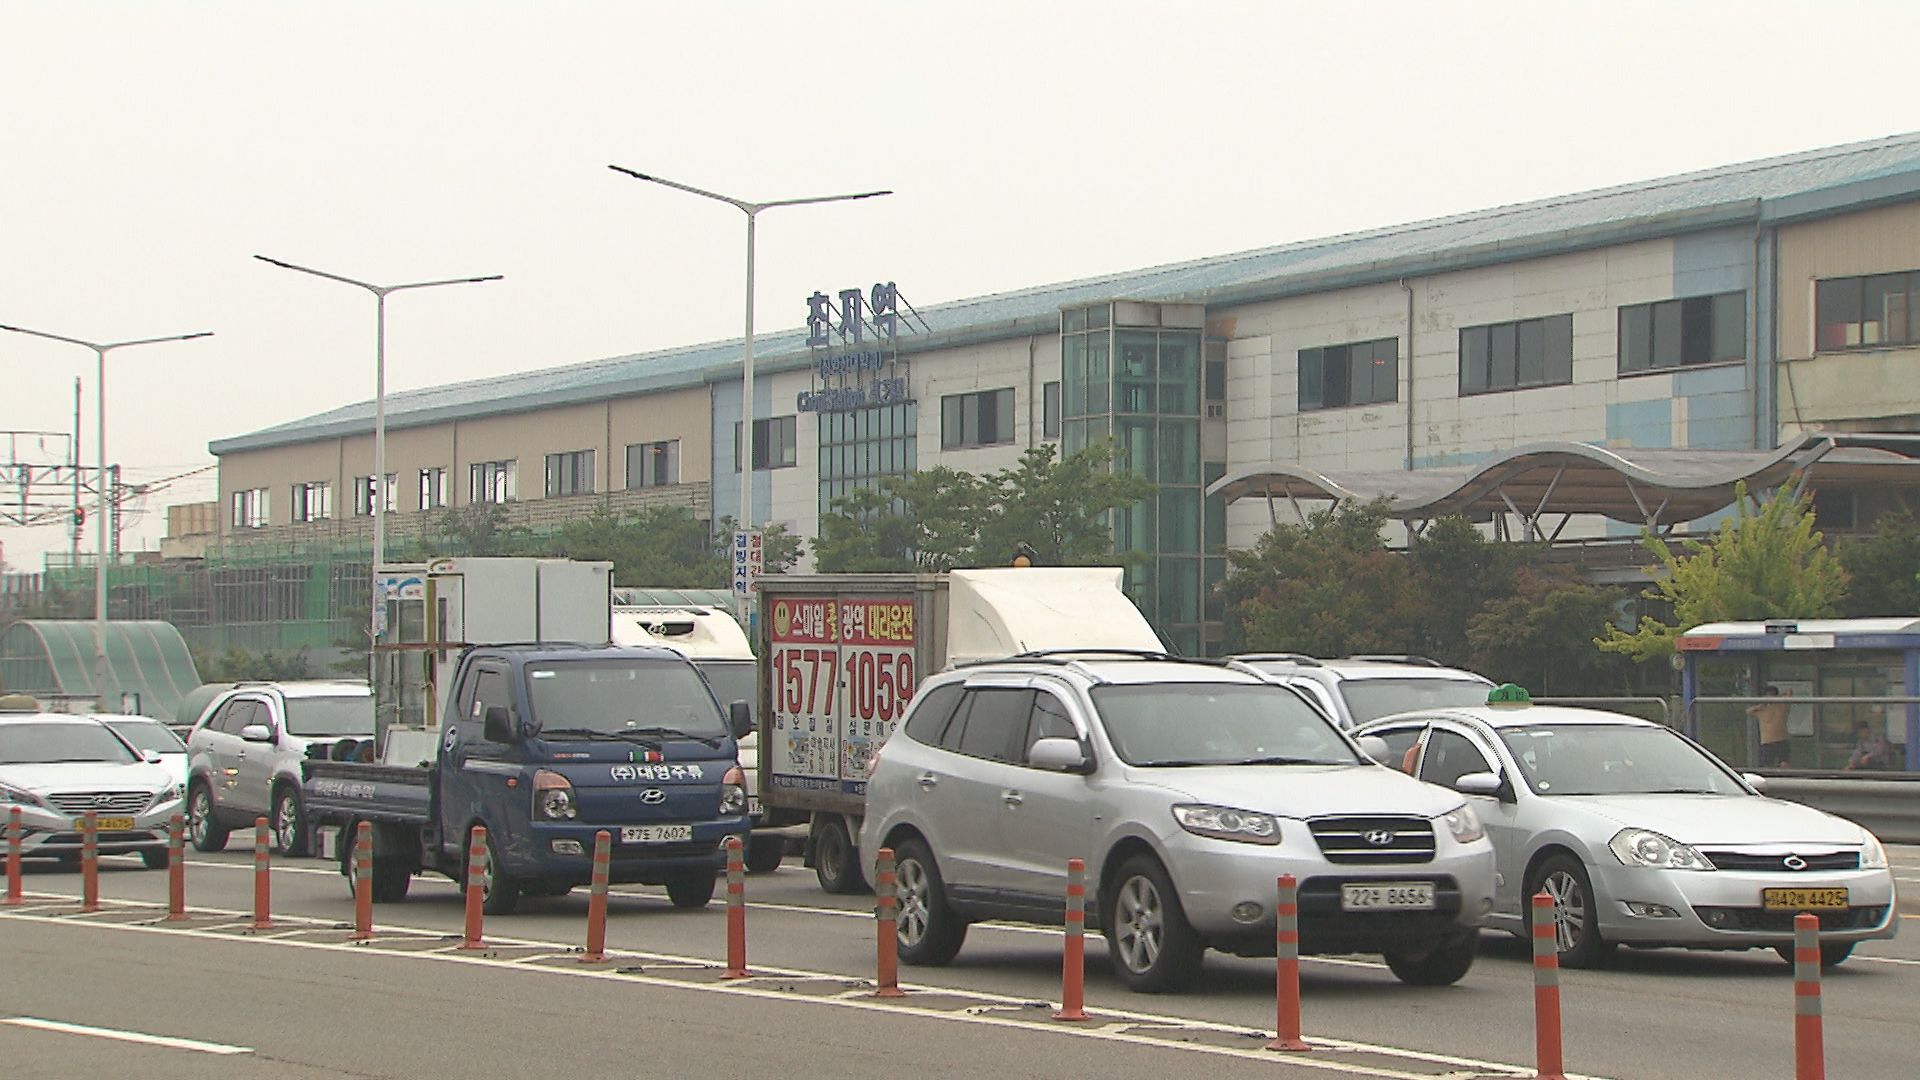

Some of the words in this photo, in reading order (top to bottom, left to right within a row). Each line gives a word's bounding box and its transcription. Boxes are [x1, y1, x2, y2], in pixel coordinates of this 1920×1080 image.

[807, 281, 897, 347] 초지역
[842, 604, 865, 640] 광역
[868, 604, 913, 640] 대리운전
[773, 649, 837, 716] 1577
[846, 651, 913, 721] 1059
